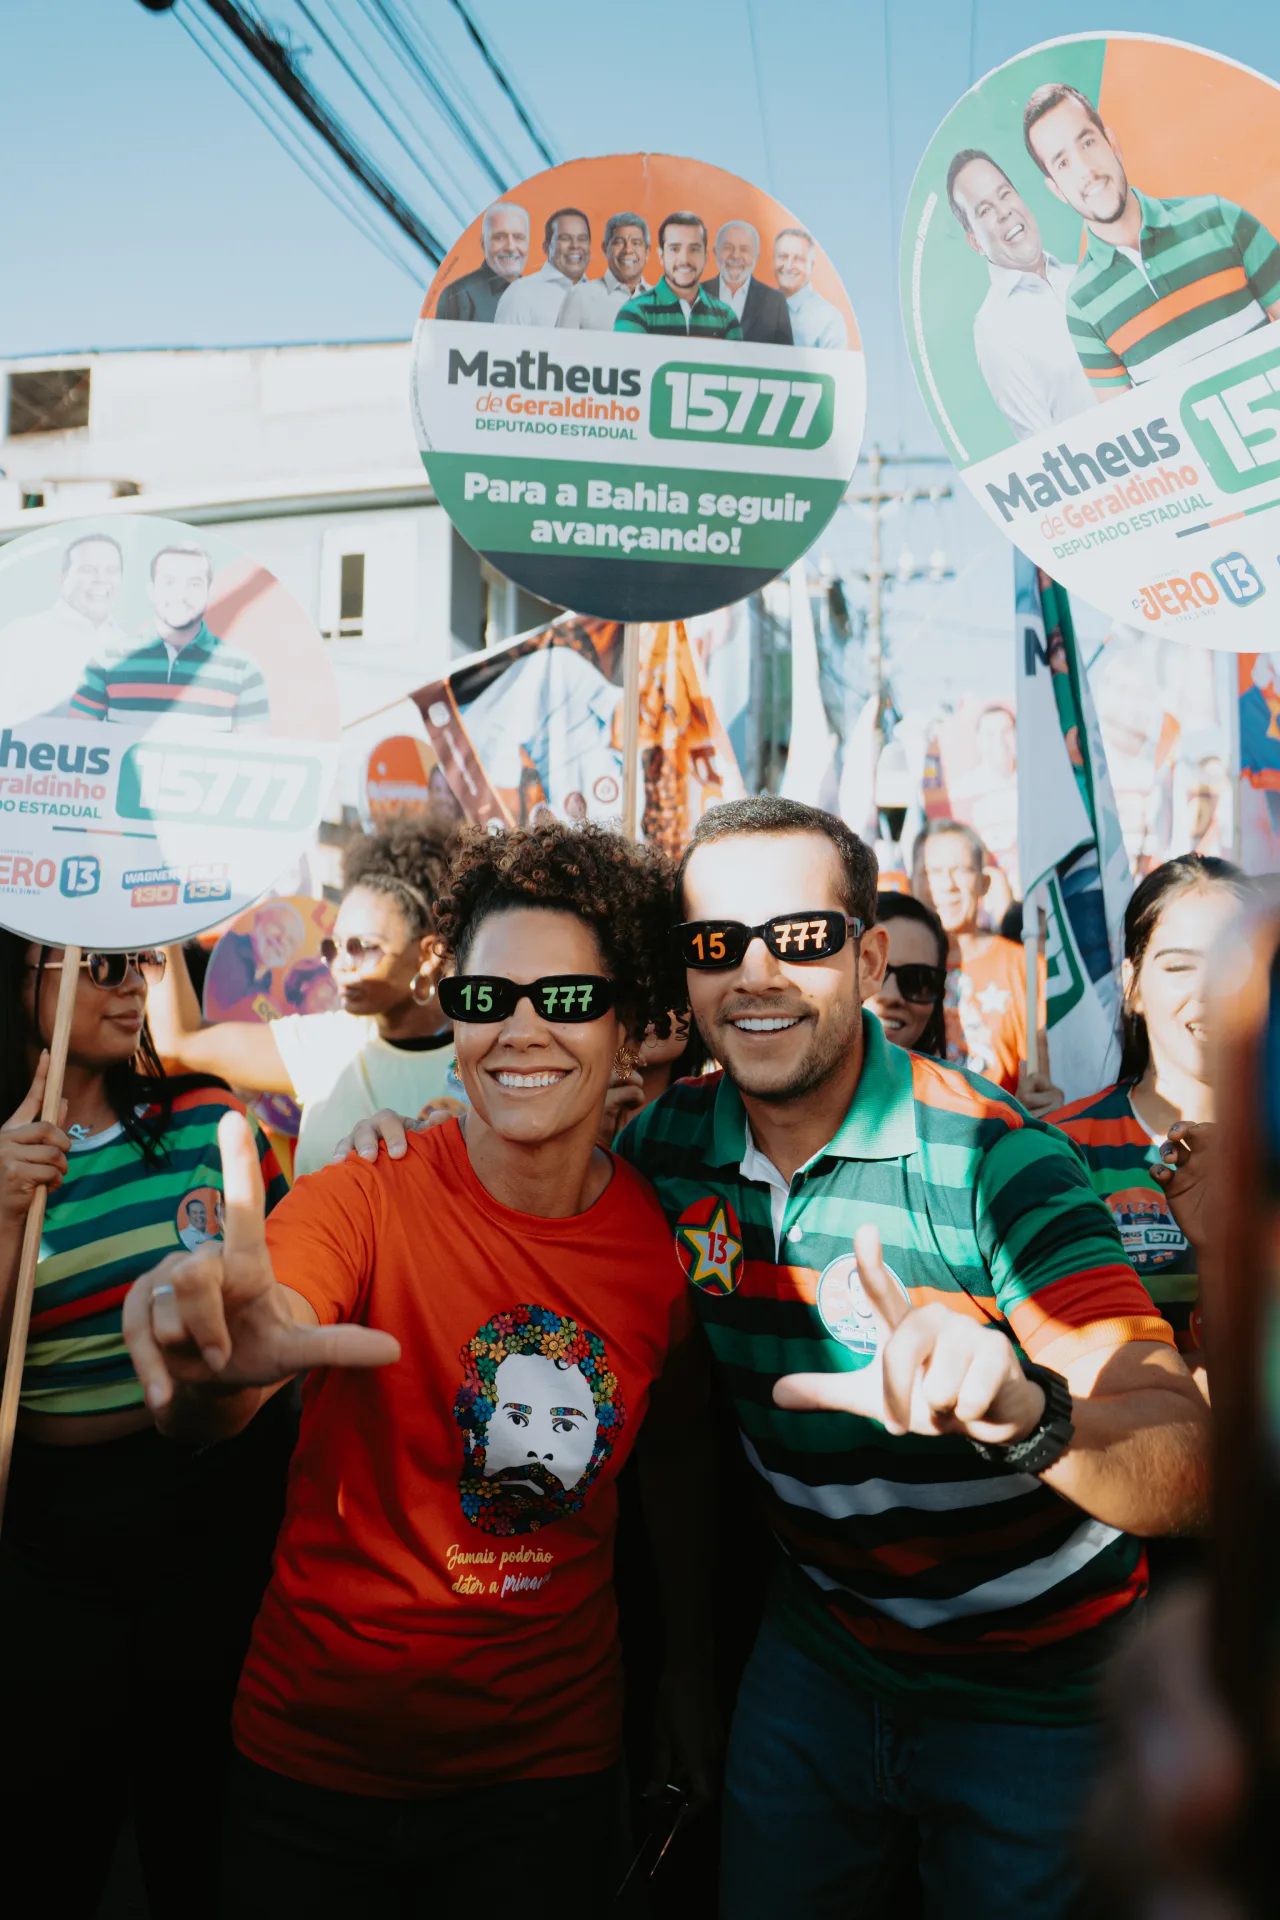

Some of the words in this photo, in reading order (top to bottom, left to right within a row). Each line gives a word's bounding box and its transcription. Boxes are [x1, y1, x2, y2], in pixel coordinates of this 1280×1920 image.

[448, 348, 641, 397] Matheus
[475, 391, 503, 413] de
[505, 393, 641, 422] Geraldinho
[665, 371, 823, 440] 15777
[1191, 365, 1280, 473] 15
[475, 417, 558, 436] DEPUTADO
[560, 422, 638, 441] ESTADUAL
[984, 417, 1181, 523] Matheus
[464, 472, 546, 505] Para
[555, 482, 578, 507] a
[587, 479, 689, 515] Bahia
[698, 492, 811, 524] seguir
[1040, 511, 1066, 540] de
[1064, 464, 1199, 530] Geraldinho
[530, 519, 741, 556] avançando!
[1052, 520, 1131, 560] DEPUTADO
[1130, 493, 1213, 532] ESTADUAL
[1139, 571, 1219, 621] JERO
[1216, 558, 1260, 599] 13
[0, 728, 110, 775] heus
[135, 750, 309, 821] 15777
[19, 800, 103, 819] ESTADUAL
[67, 860, 97, 892] 13
[692, 932, 726, 960] 15
[773, 919, 828, 954] 777
[460, 984, 493, 1013] 15
[543, 984, 593, 1014] 777
[708, 1232, 728, 1265] 13
[446, 1544, 497, 1571] Jamais
[498, 1544, 554, 1570] poderão
[451, 1574, 485, 1595] deter
[488, 1580, 500, 1594] a
